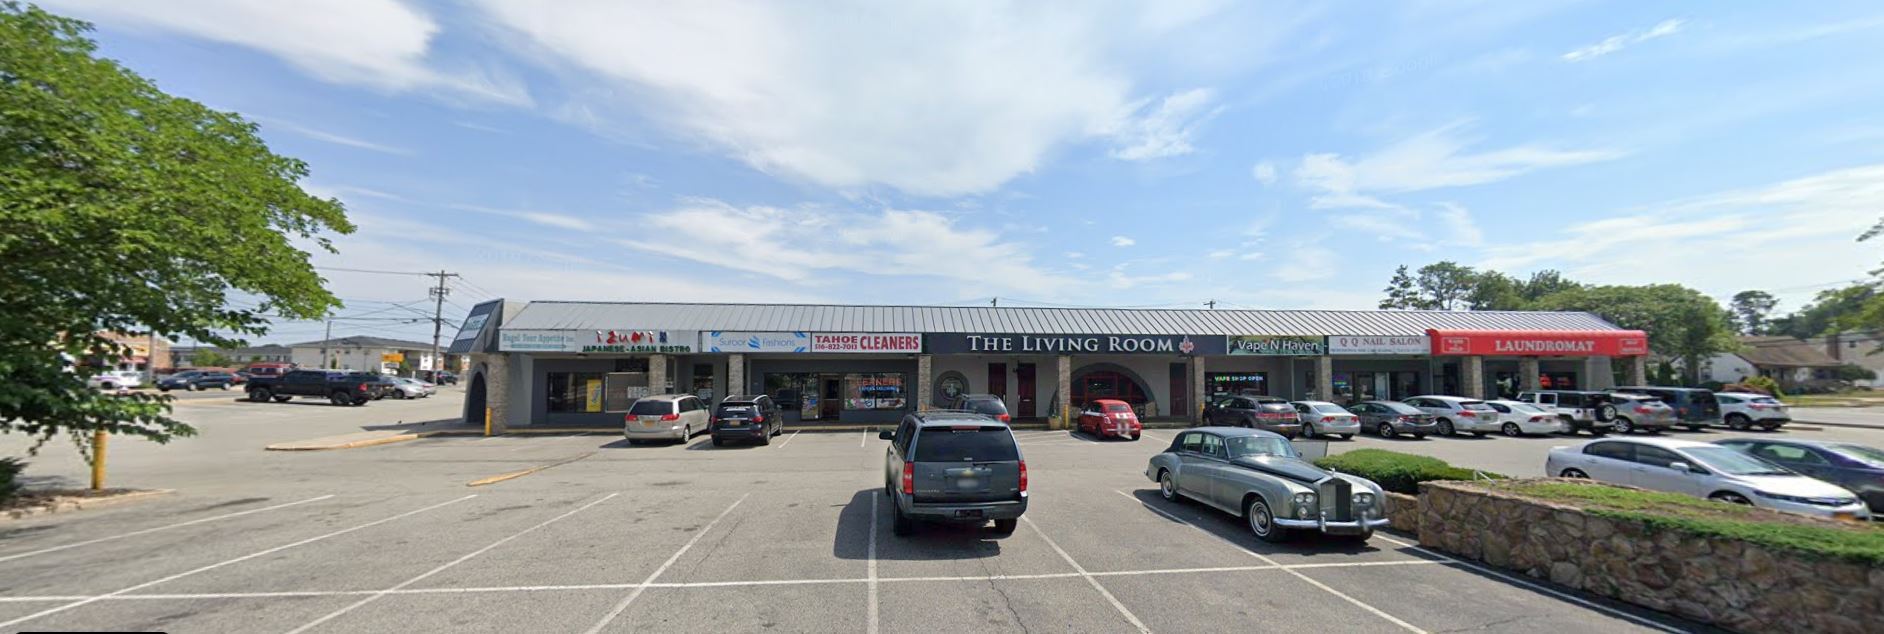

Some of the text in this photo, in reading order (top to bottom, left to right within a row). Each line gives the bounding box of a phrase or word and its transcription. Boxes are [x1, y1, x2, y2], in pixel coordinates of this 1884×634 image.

[762, 337, 796, 347] Fashions
[815, 335, 858, 344] TAHOE
[860, 335, 919, 350] CLEANERS
[1340, 337, 1347, 346] Q
[1351, 337, 1358, 346] Q
[1389, 337, 1421, 346] SALON
[660, 345, 691, 353] BISTRO
[1237, 340, 1318, 353] Vape N Haven
[1495, 340, 1595, 352] LAUNDROMAT
